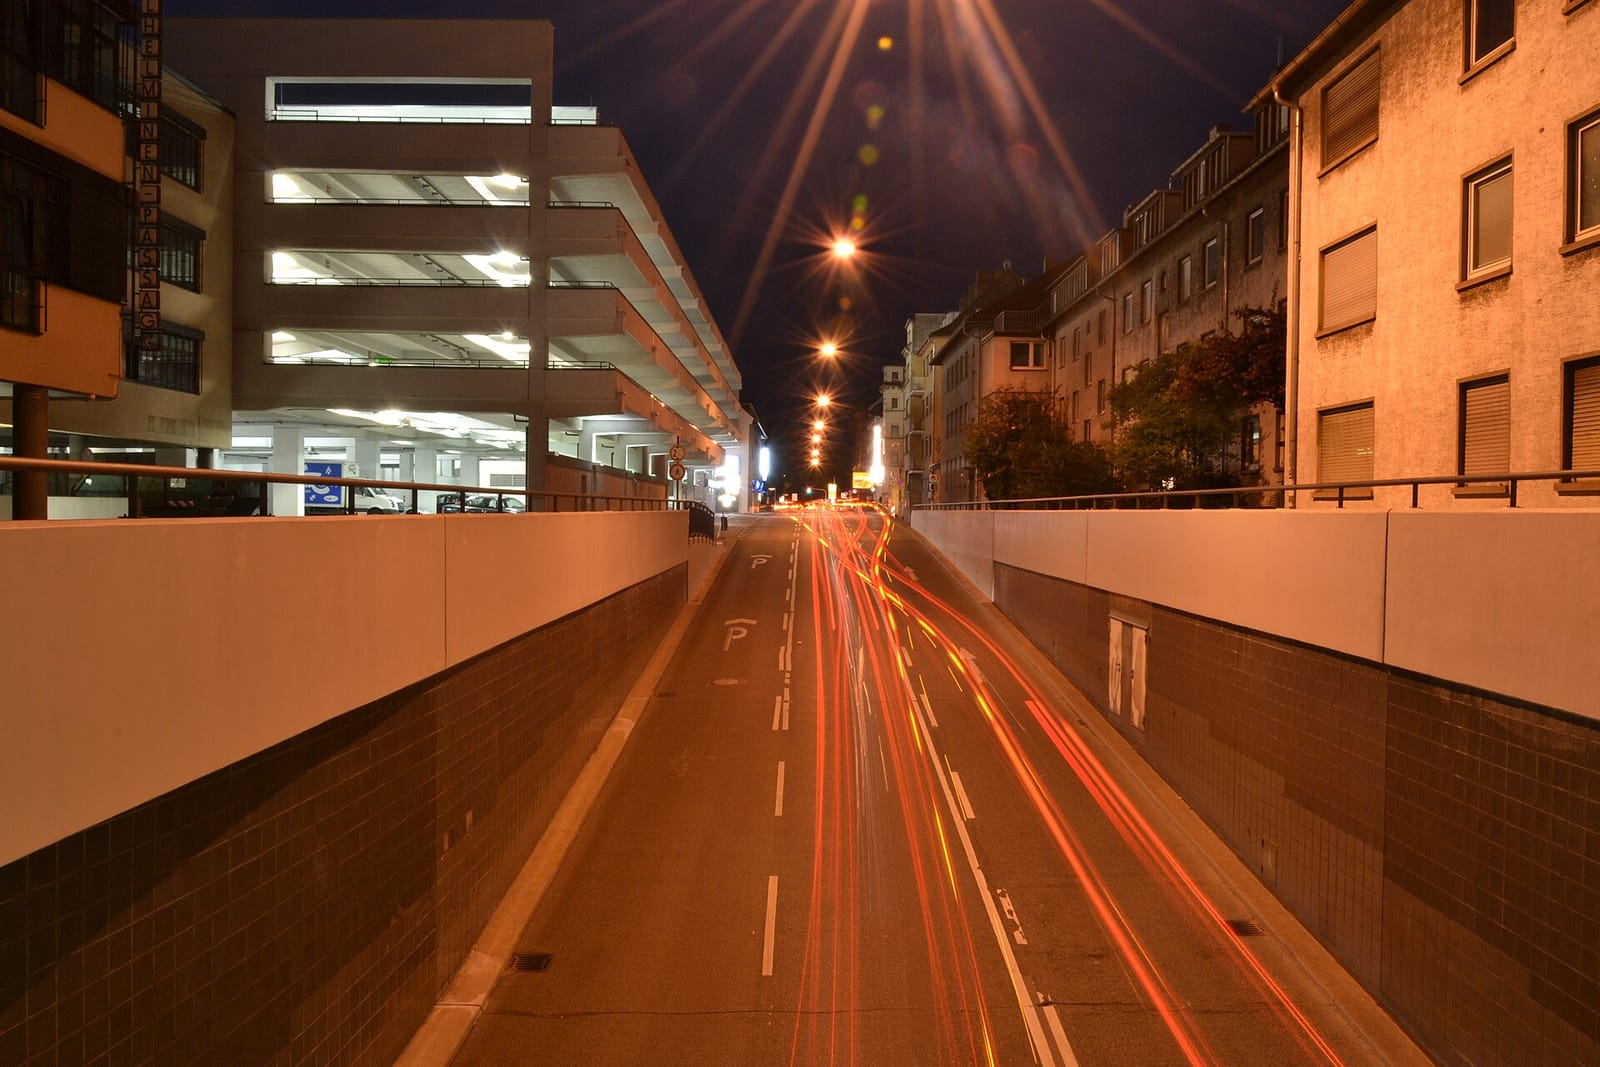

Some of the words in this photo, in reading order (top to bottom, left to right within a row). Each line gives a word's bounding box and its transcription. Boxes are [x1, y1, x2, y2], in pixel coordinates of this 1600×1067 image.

[140, 0, 157, 350] LHELMINEN-PASSAG
[751, 558, 768, 569] P
[723, 627, 748, 652] P
